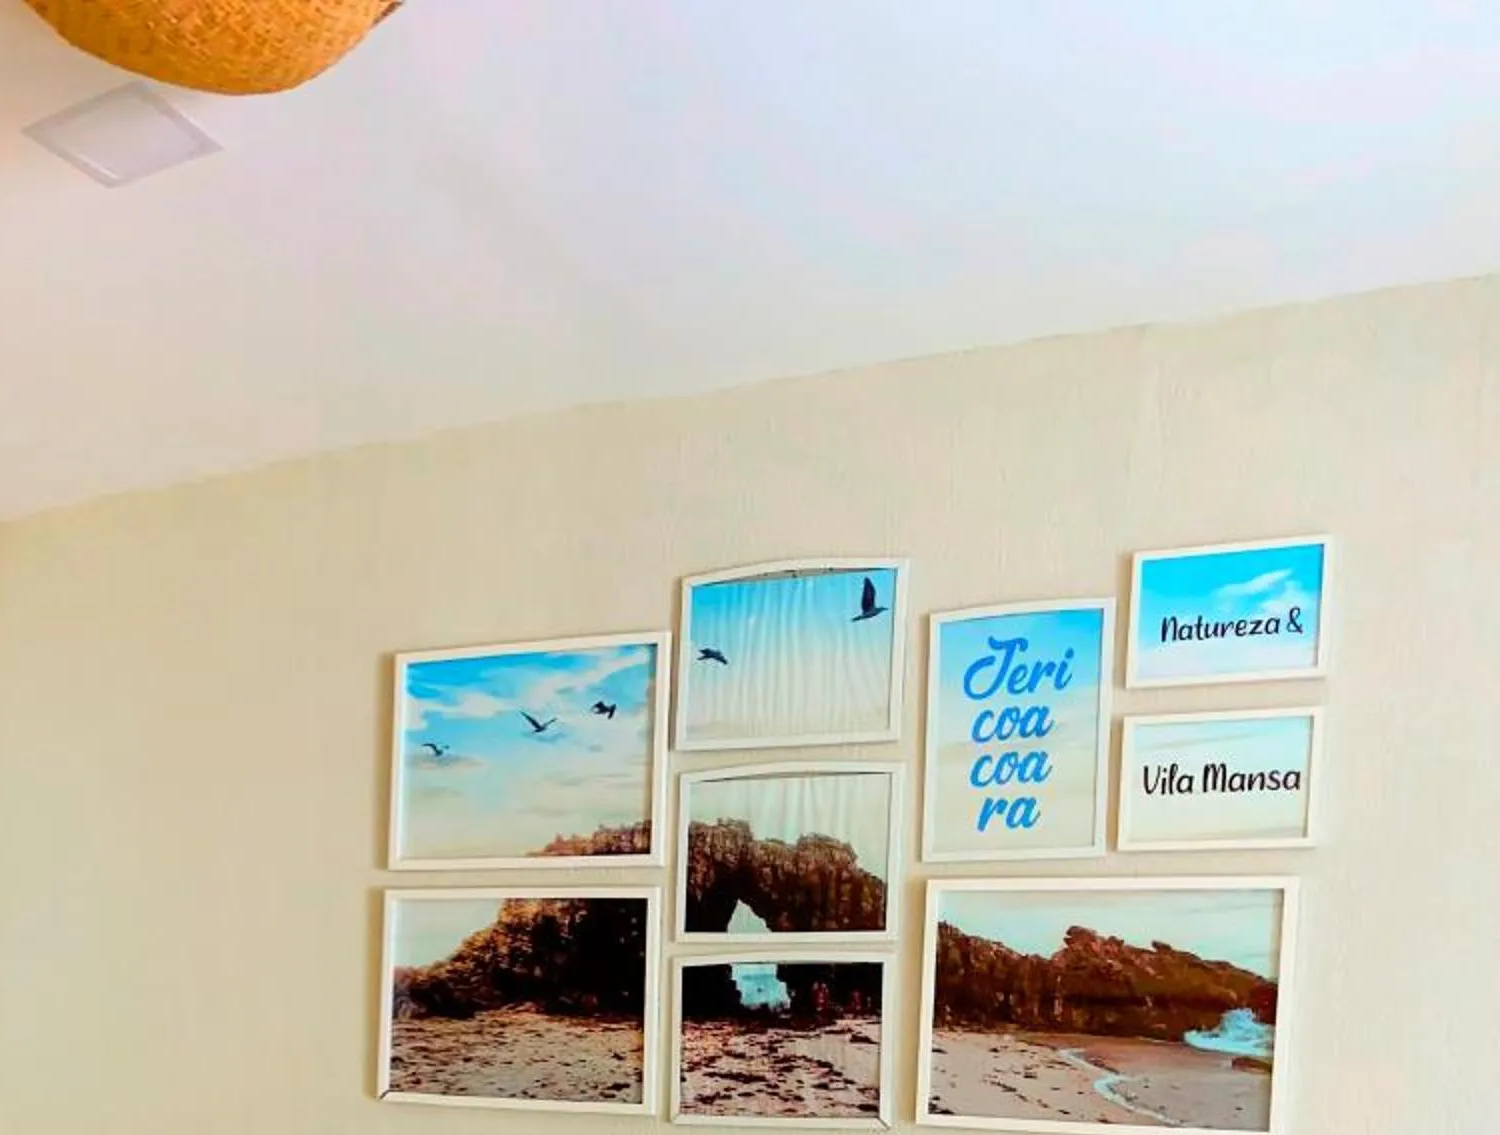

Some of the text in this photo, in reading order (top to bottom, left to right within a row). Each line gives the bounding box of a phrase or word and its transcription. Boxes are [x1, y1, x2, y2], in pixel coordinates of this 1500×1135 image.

[1160, 606, 1303, 643] Natureza &
[962, 635, 1075, 701] Jeri
[970, 704, 1054, 742] coa
[969, 749, 1053, 788] coa
[1142, 762, 1302, 797] Vila Mansa
[976, 796, 1041, 832] ra
